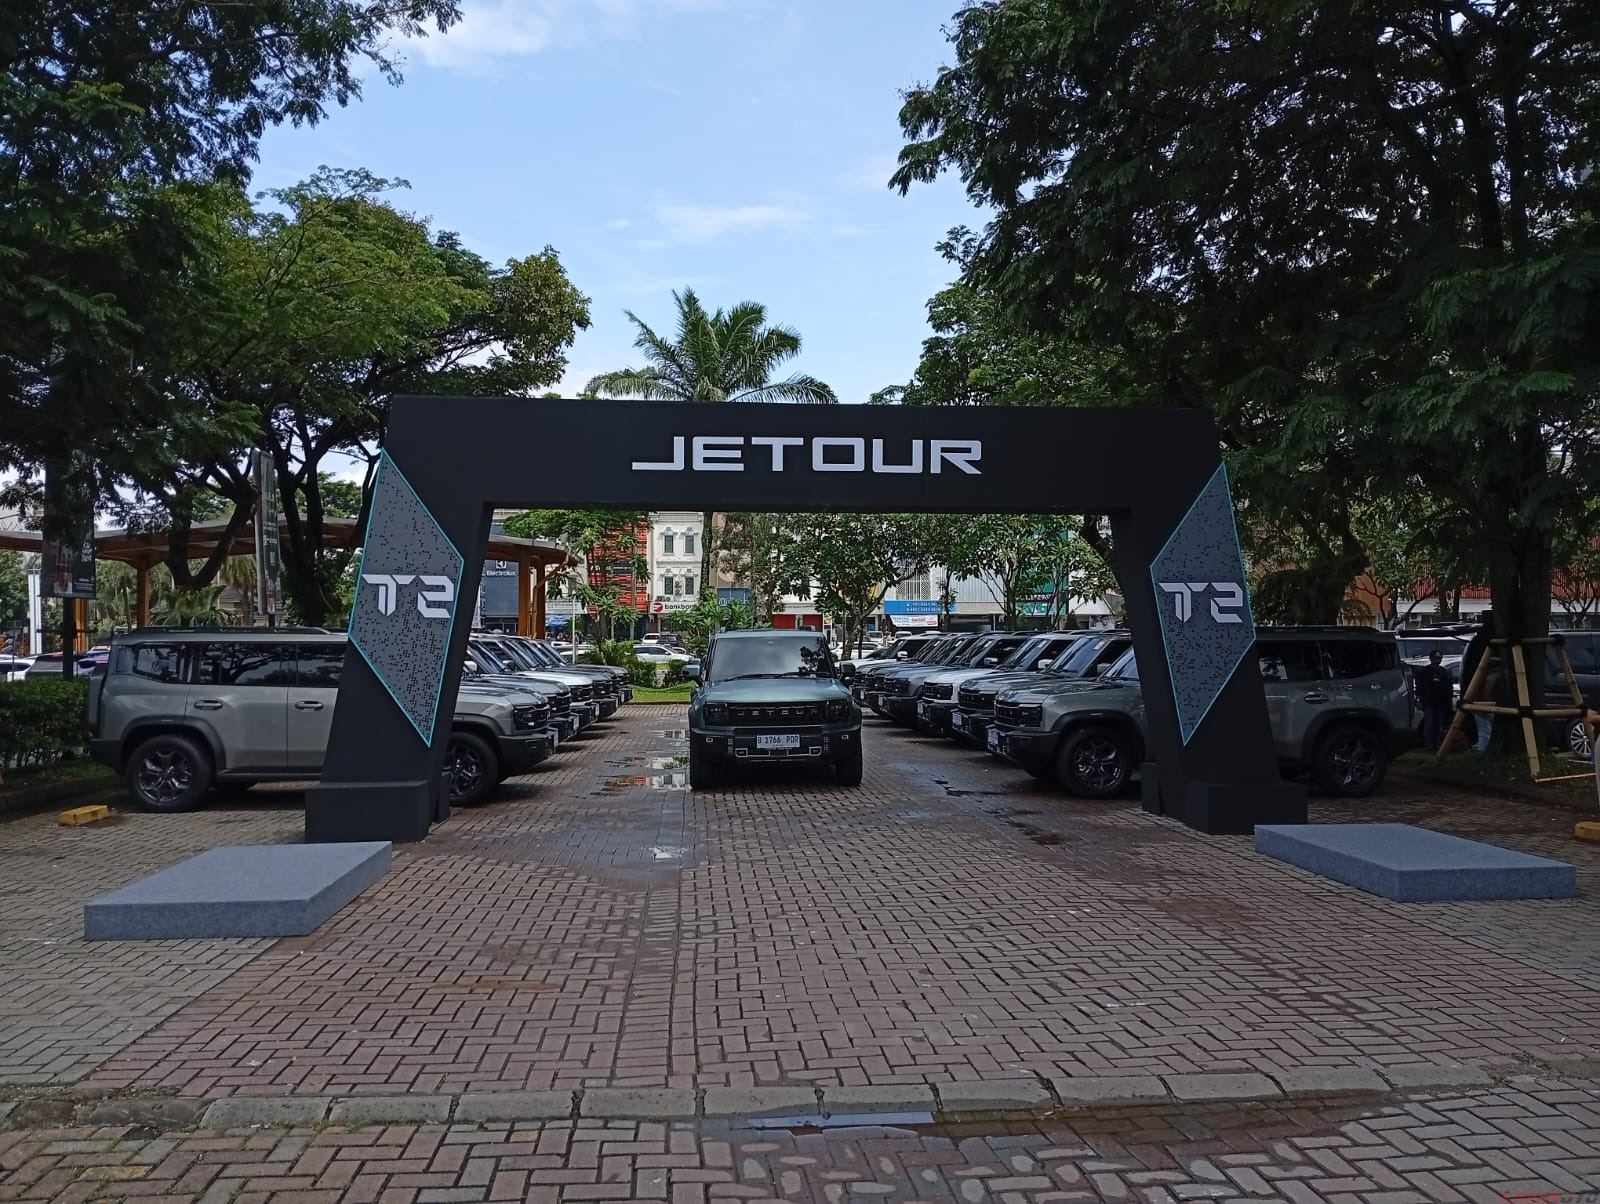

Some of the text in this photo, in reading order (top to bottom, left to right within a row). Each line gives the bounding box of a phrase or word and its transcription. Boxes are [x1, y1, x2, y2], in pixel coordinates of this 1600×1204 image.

[631, 436, 982, 475] JETOUR
[486, 569, 516, 577] Electrolux
[361, 574, 455, 618] T2
[1158, 582, 1243, 623] T2
[737, 708, 818, 716] JETOUR
